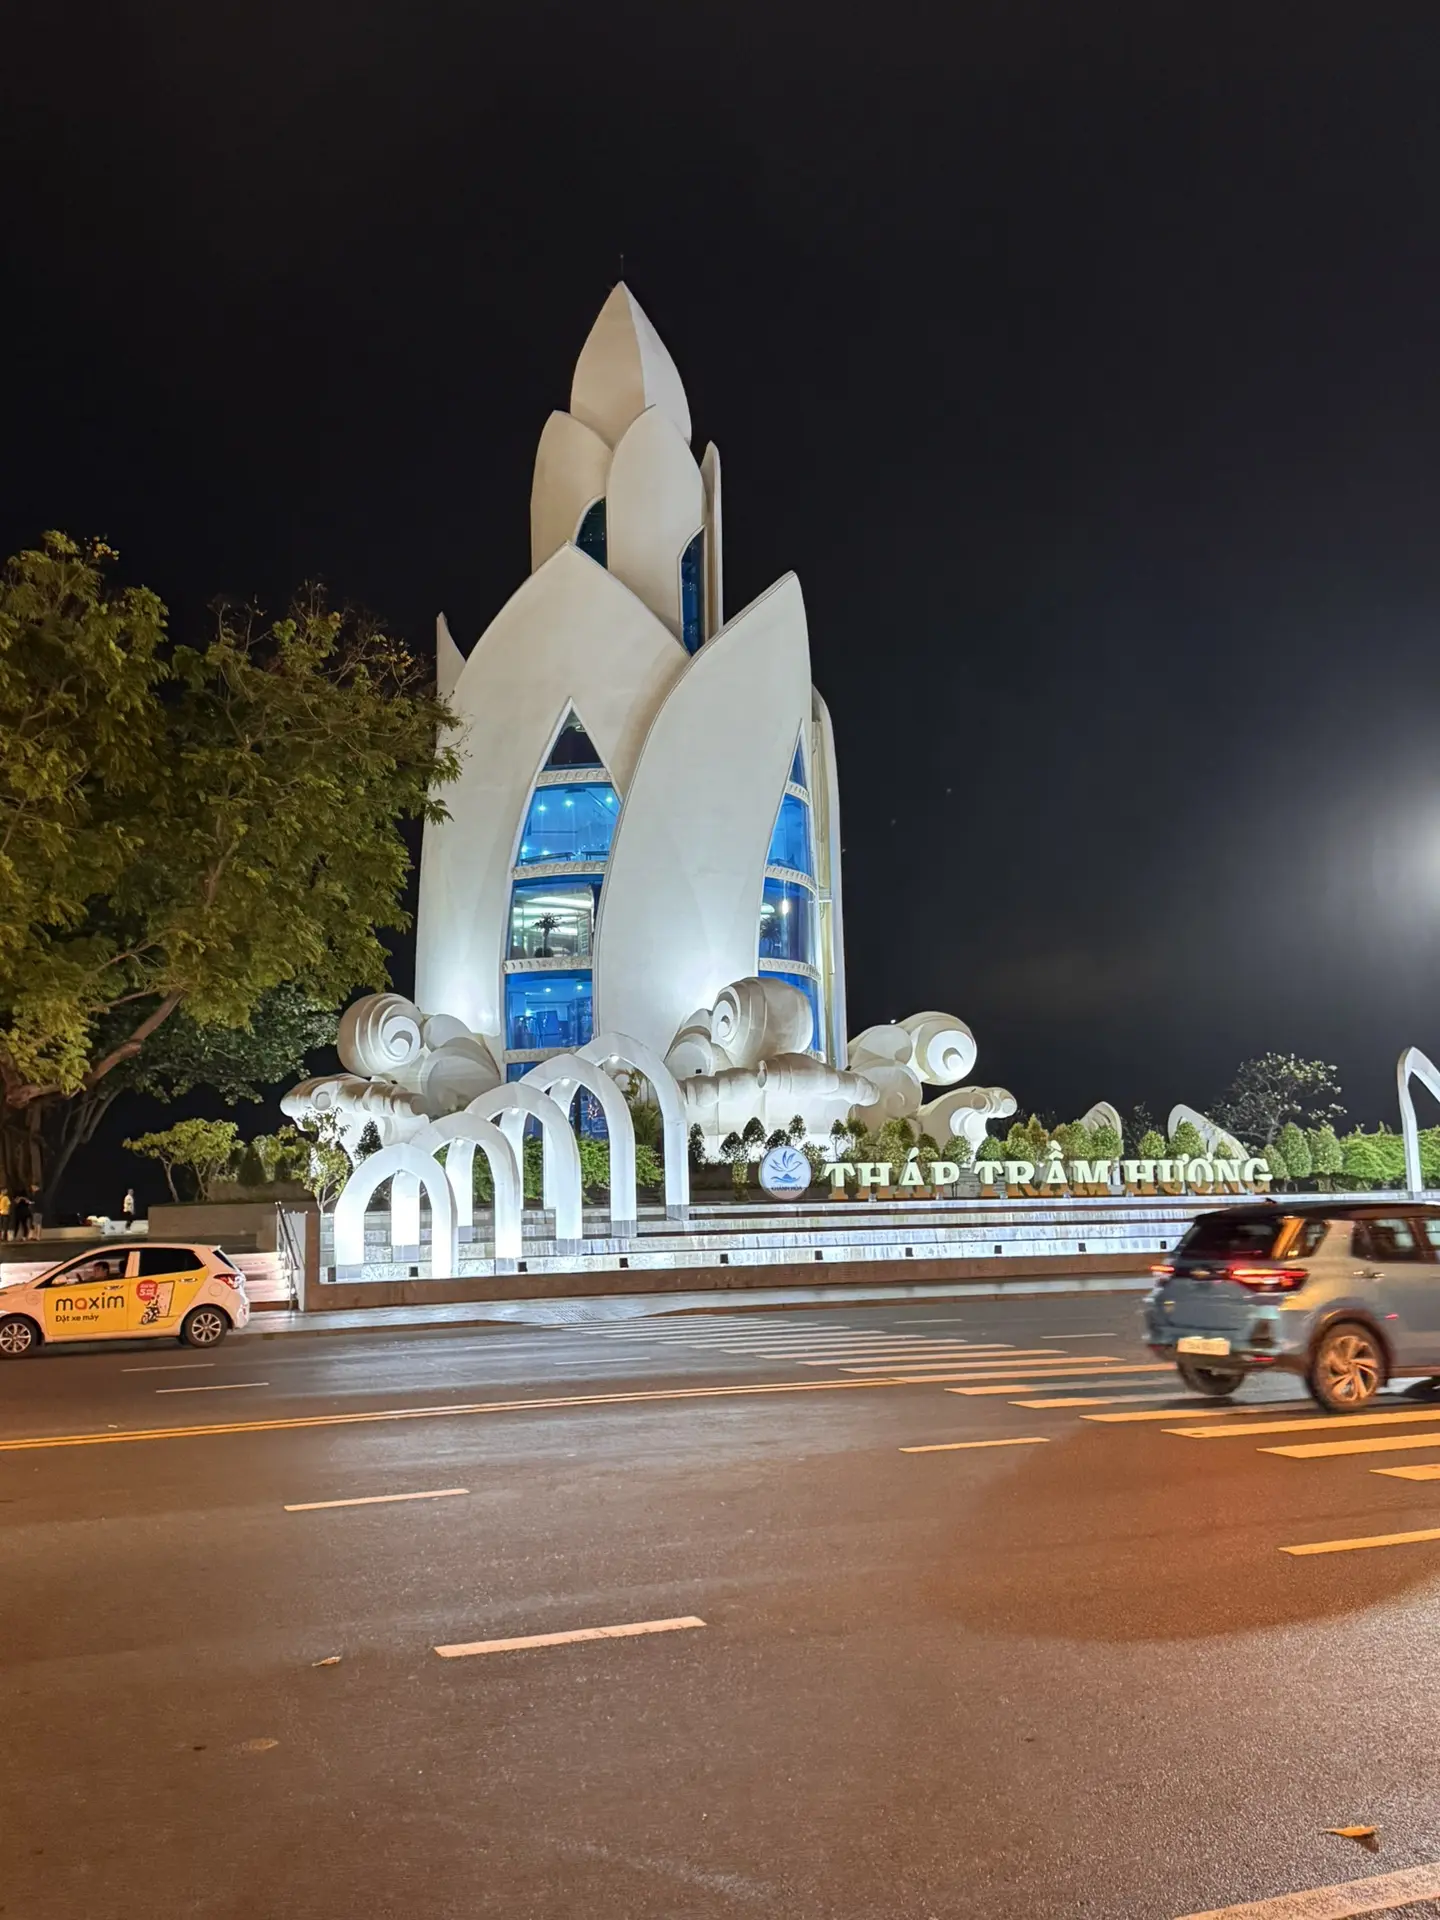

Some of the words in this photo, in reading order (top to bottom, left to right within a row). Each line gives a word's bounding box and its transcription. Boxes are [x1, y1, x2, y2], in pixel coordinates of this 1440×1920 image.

[823, 1147, 960, 1199] THÁP
[1122, 1152, 1273, 1196] HƯƠNG
[56, 1292, 124, 1311] maxim
[55, 1315, 70, 1324] Đặt
[82, 1313, 99, 1322] máy
